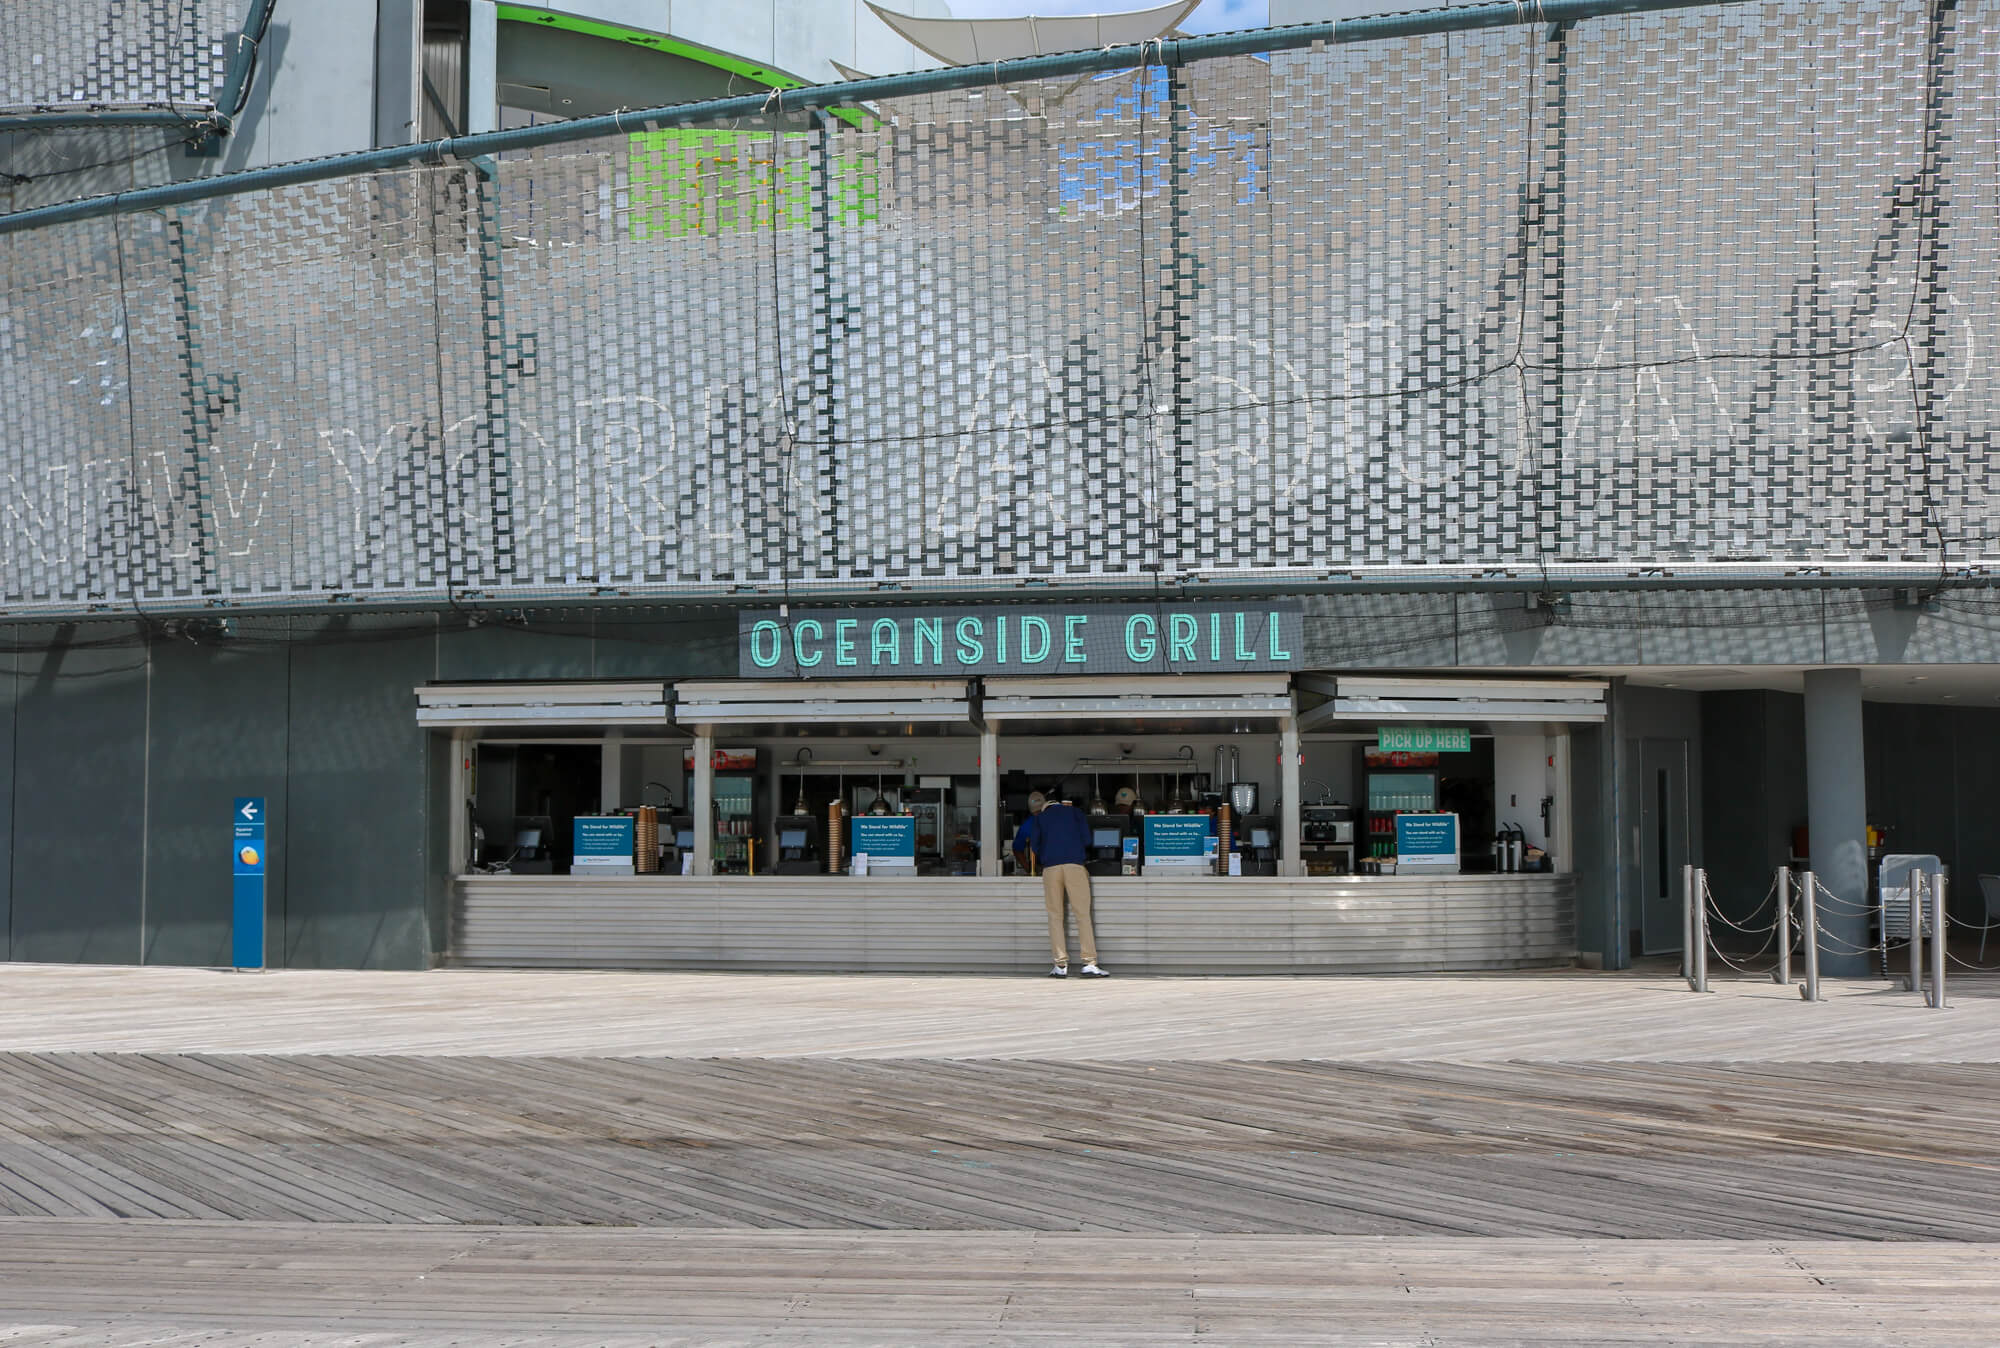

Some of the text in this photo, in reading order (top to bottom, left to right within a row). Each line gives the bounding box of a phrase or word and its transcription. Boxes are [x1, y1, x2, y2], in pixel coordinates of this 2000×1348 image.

[750, 611, 1292, 667] OCEANSIDE GRILL
[1383, 734, 1468, 749] PICK UP HERE
